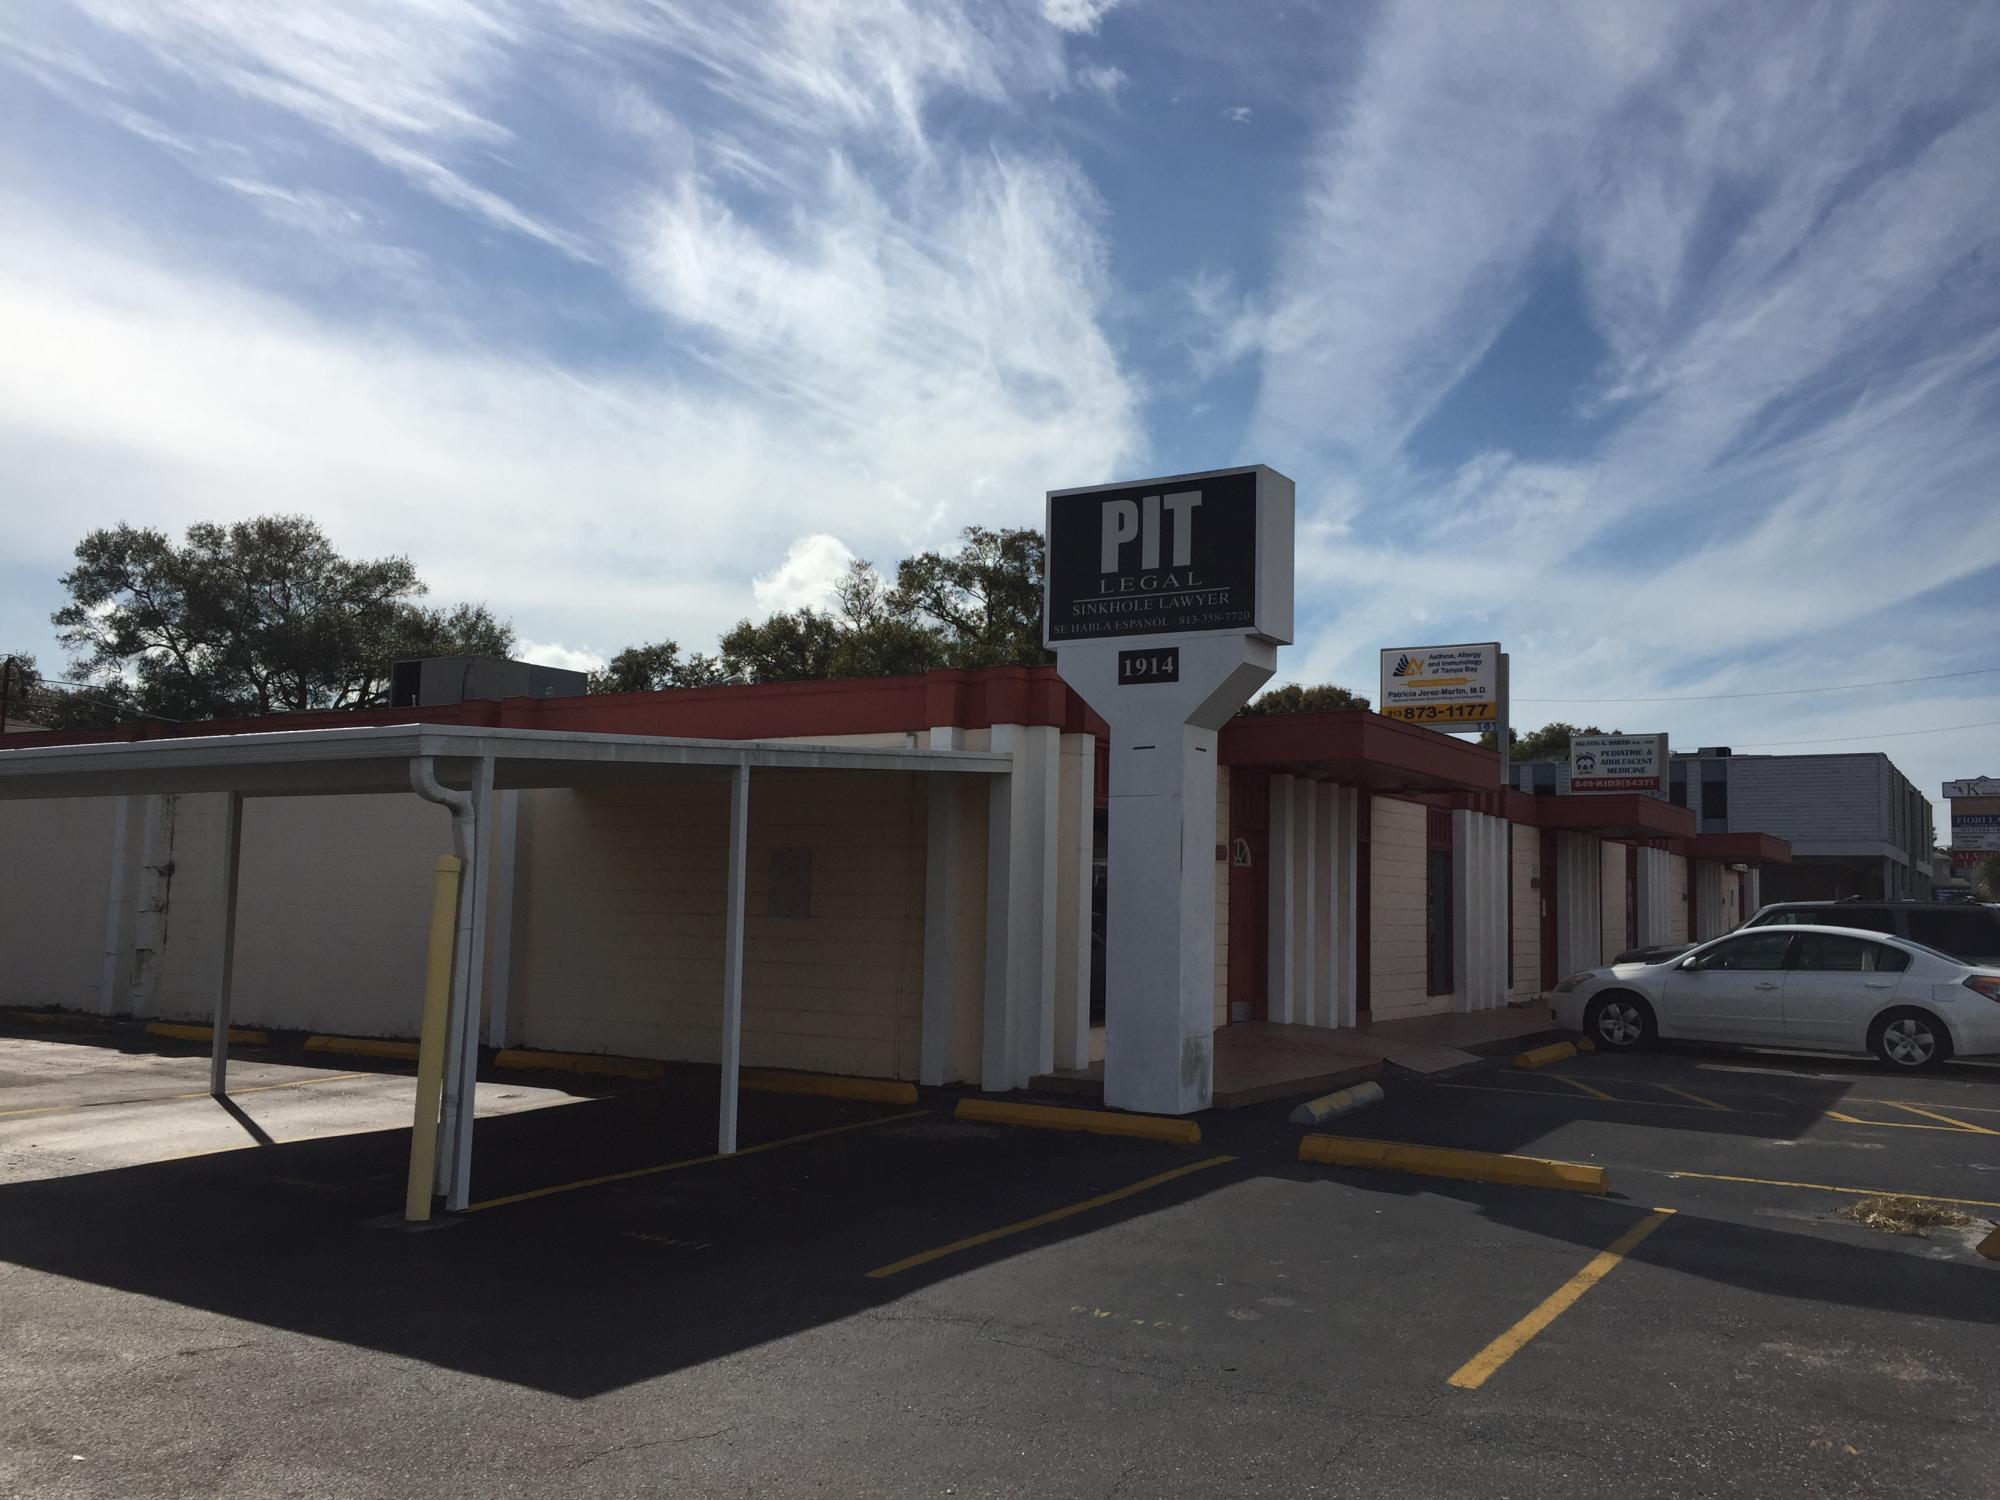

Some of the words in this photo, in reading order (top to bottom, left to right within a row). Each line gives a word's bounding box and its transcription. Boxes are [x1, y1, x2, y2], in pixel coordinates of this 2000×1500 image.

[1100, 490, 1203, 574] PIT
[1100, 571, 1203, 594] LEGAL
[1072, 599, 1154, 616] SINKHOLE
[1159, 592, 1230, 609] LAWYER
[1054, 623, 1068, 634] SE
[1071, 620, 1114, 633] HABLA
[1457, 651, 1482, 660] Allergy
[1122, 655, 1174, 677] 1914
[1441, 659, 1482, 668] Immunology
[1441, 667, 1463, 675] Tampa
[1465, 665, 1478, 674] Bay
[1388, 689, 1416, 698] Patricia
[1403, 703, 1489, 720] 873-1177
[1600, 749, 1644, 757] PEDIATRIC
[1600, 758, 1653, 766] ADOLESCENT
[1607, 766, 1646, 774] MEDICINE
